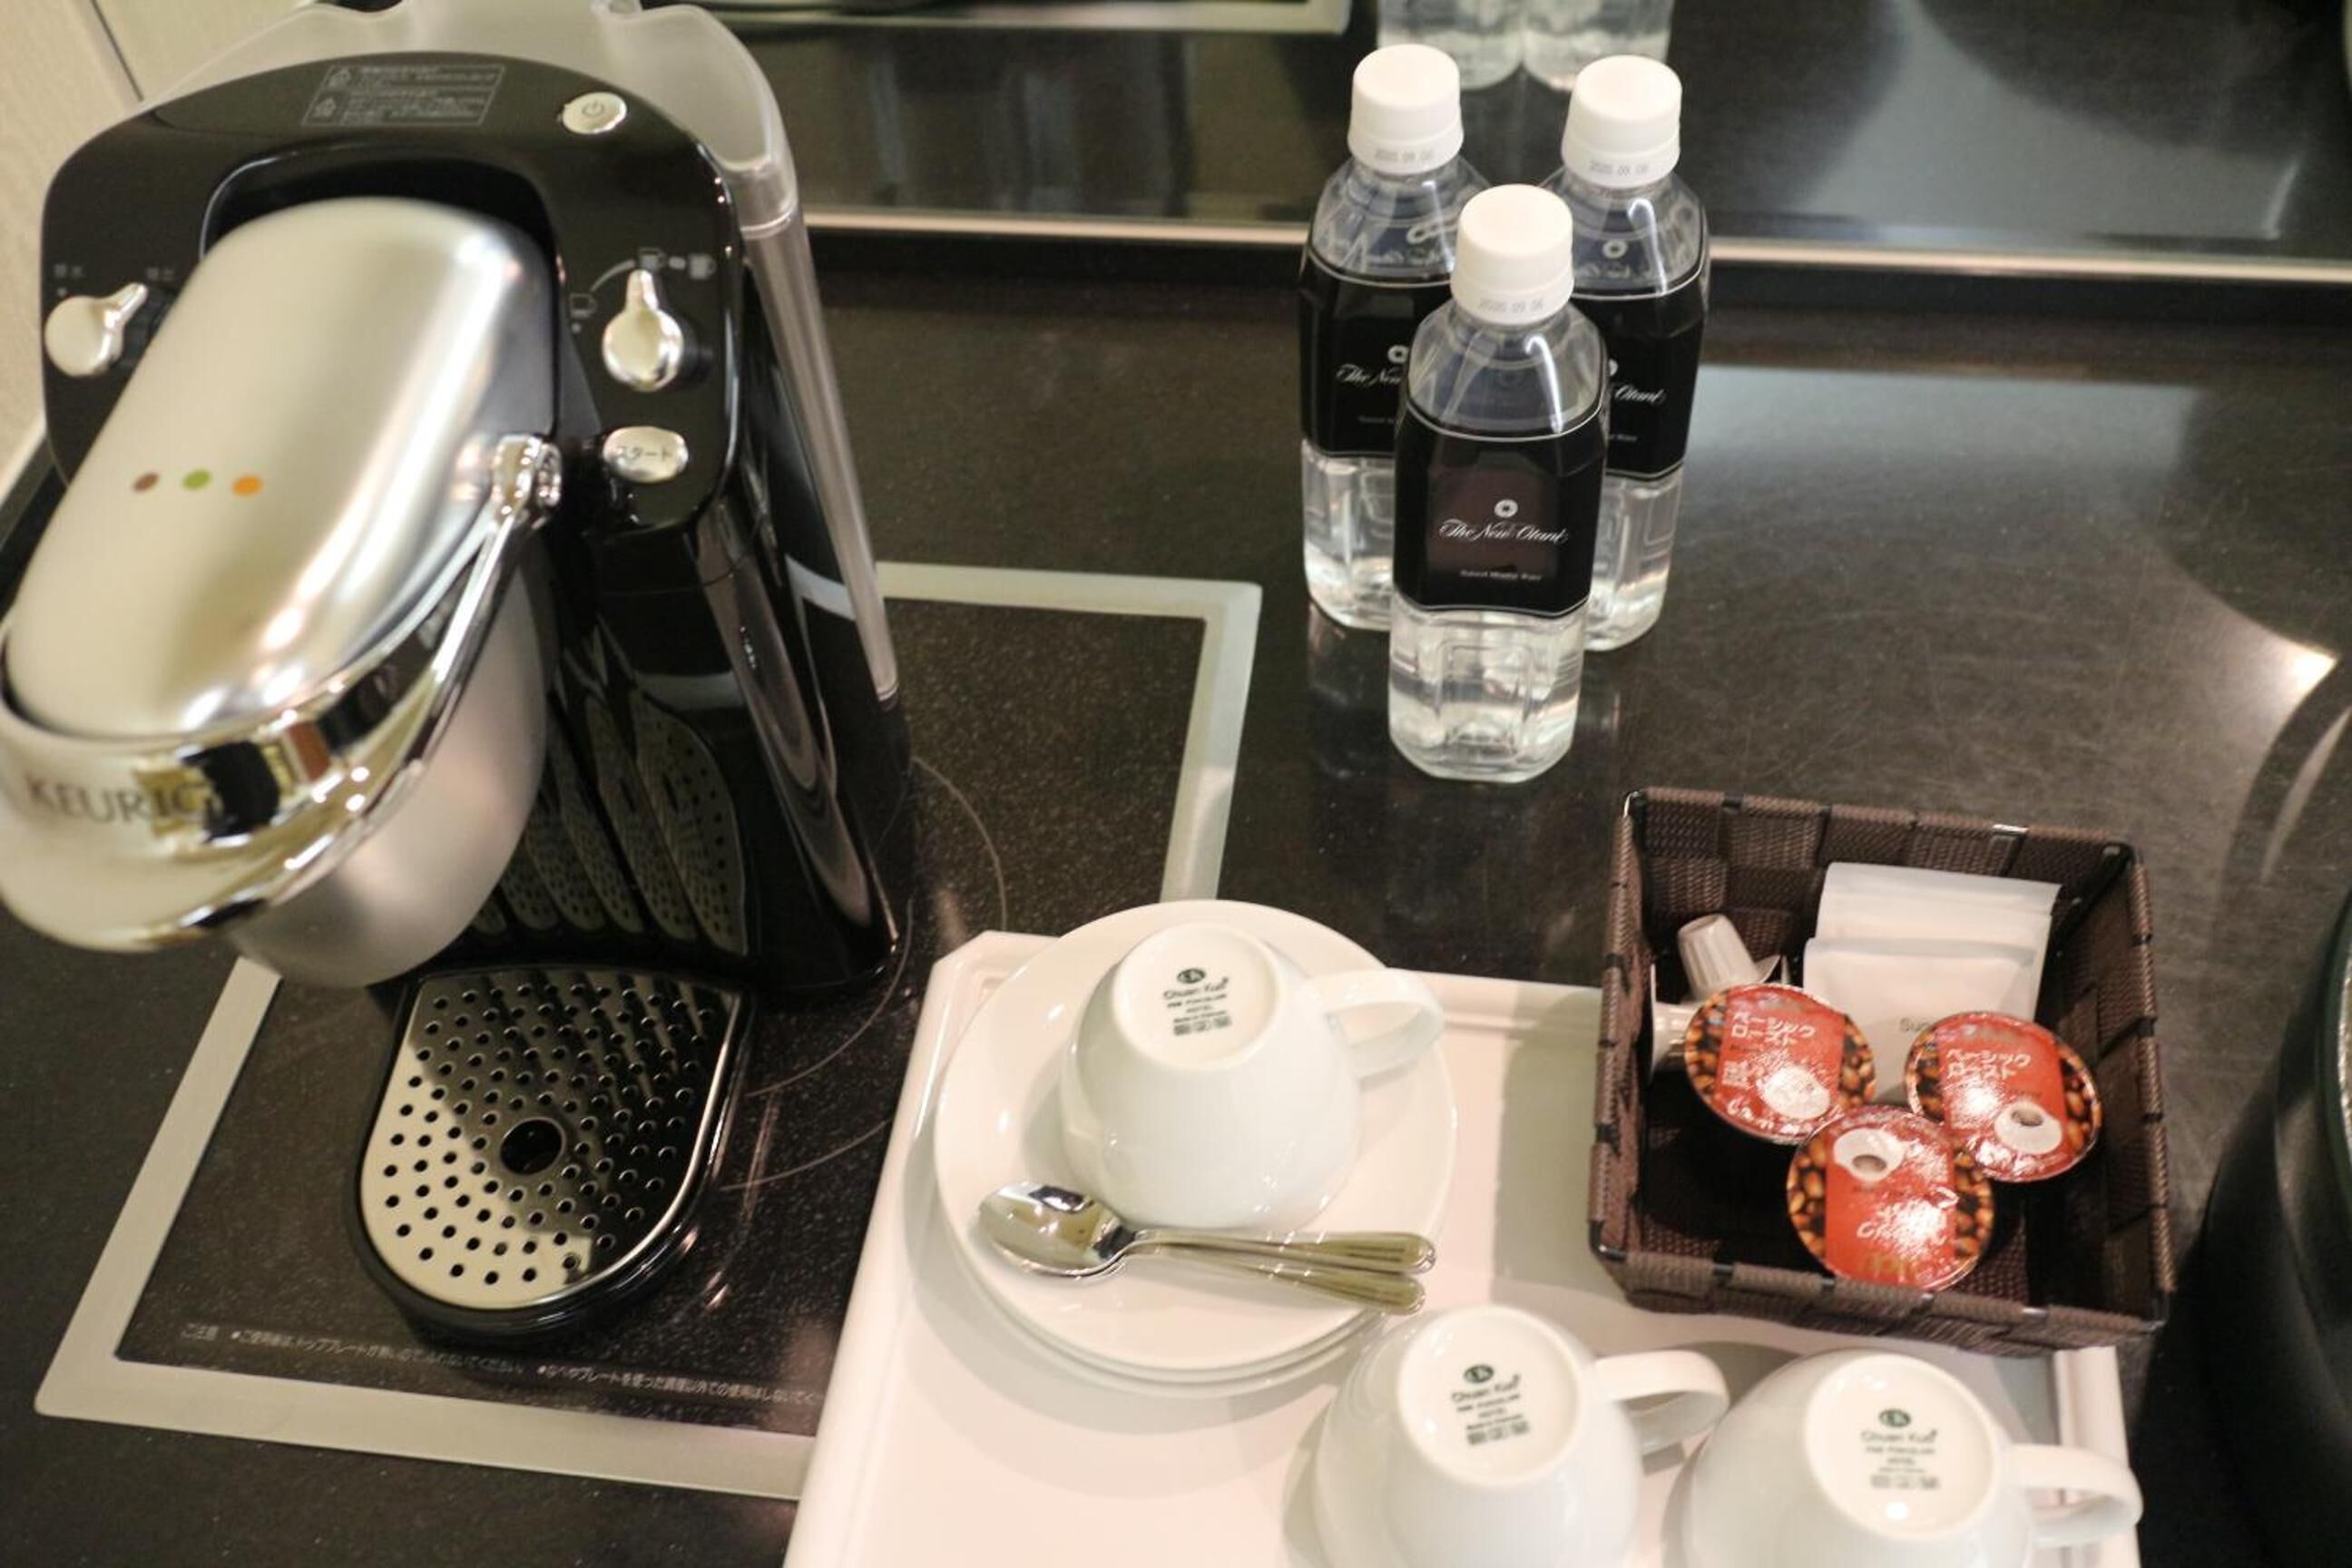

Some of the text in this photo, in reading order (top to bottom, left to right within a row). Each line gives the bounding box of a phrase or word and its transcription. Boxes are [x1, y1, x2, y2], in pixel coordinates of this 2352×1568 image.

[1439, 517, 1474, 540] The
[1472, 520, 1517, 542] New
[24, 771, 214, 824] KEURIG
